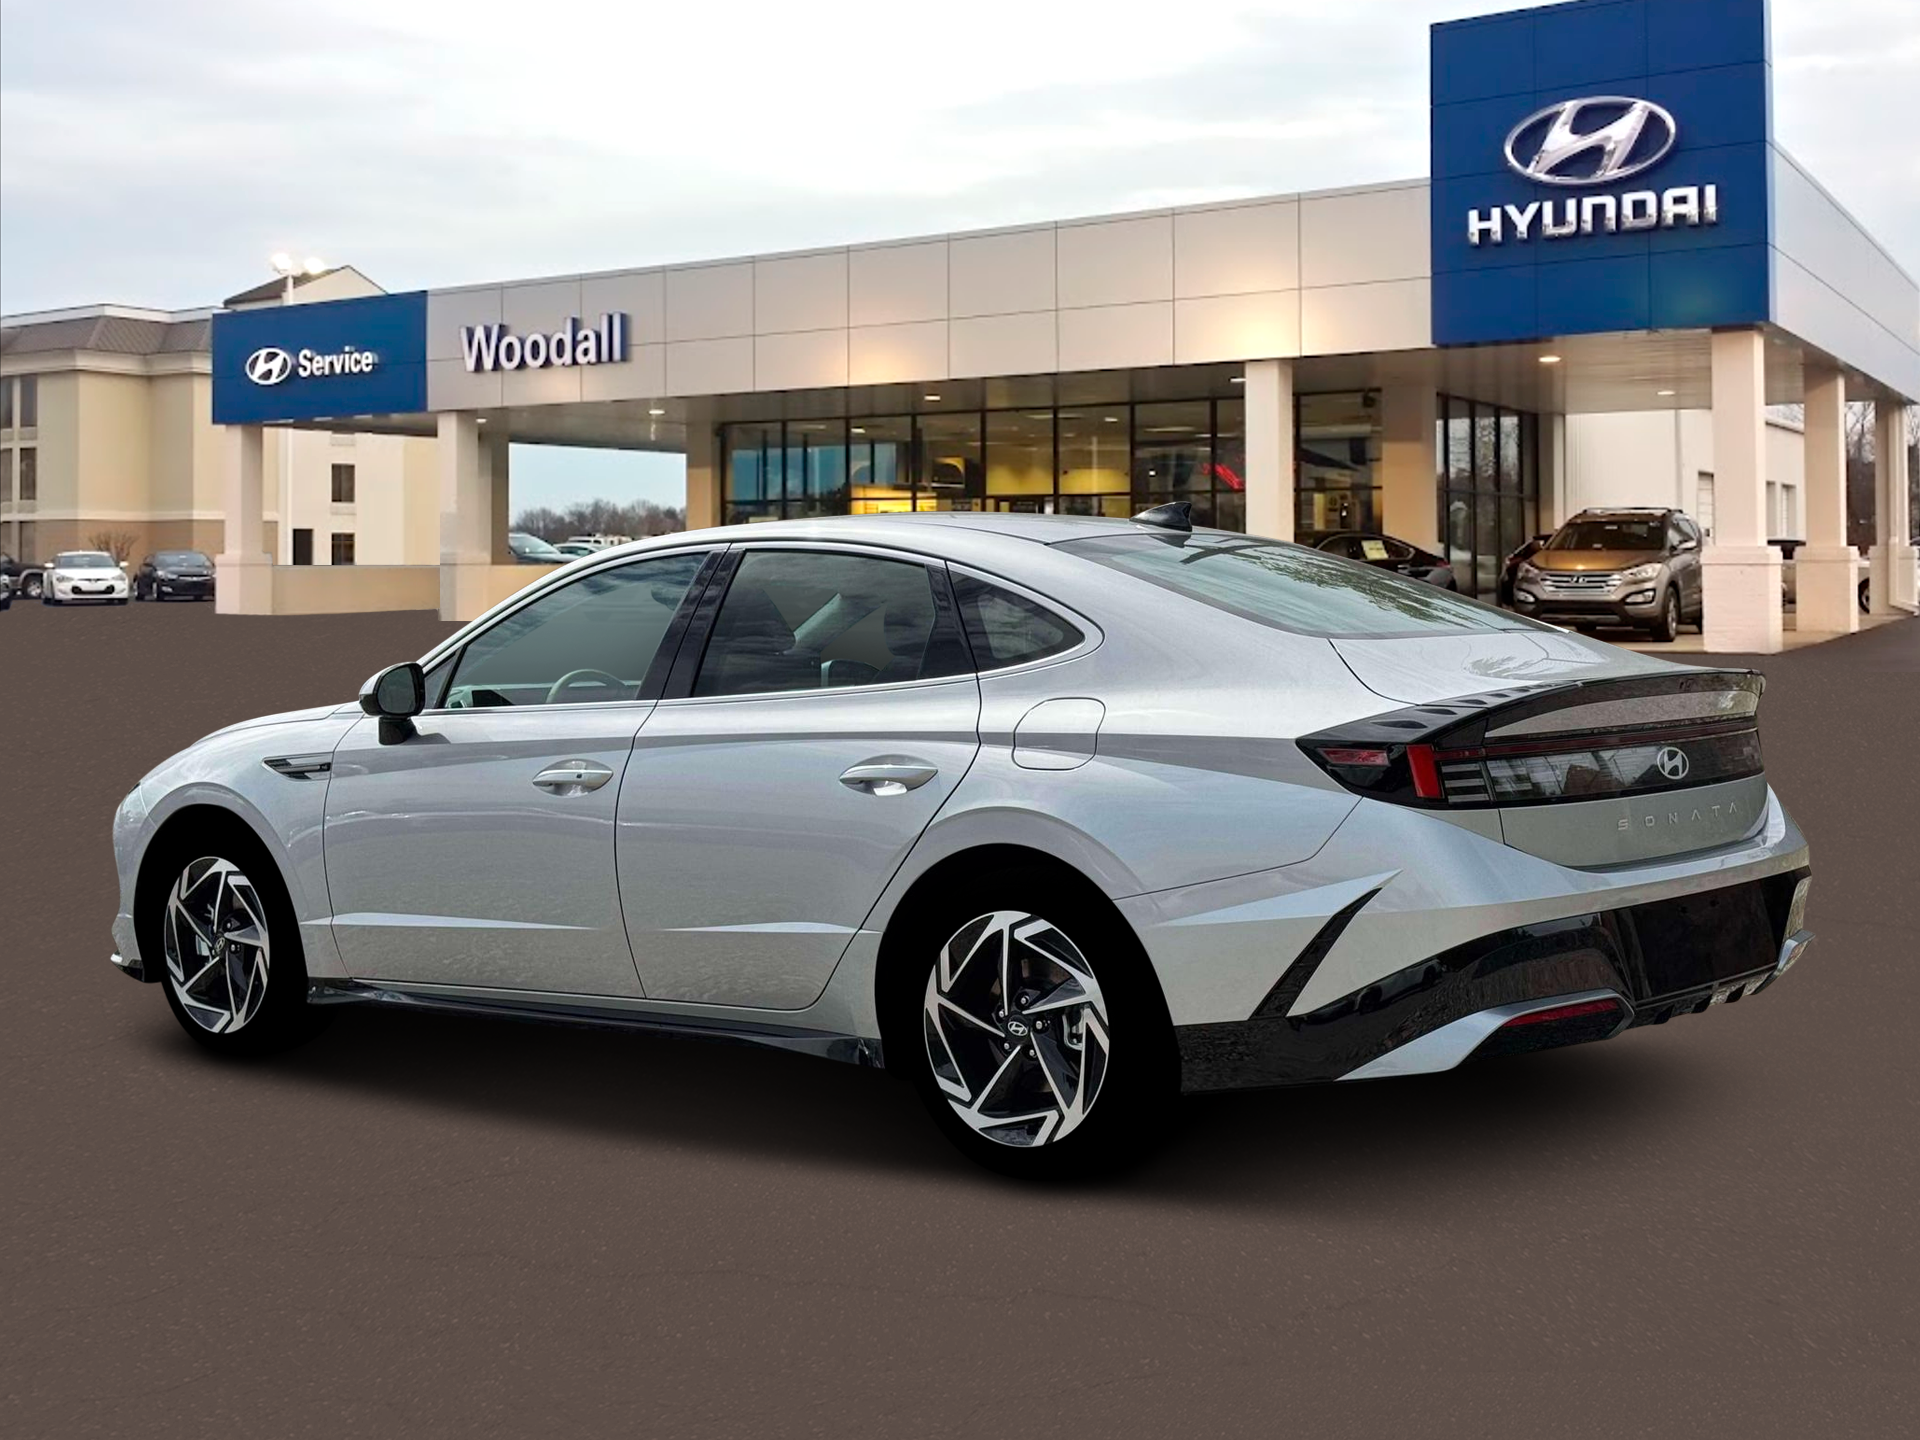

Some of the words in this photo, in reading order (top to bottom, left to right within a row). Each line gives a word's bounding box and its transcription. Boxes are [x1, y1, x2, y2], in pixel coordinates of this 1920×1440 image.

[1468, 184, 1717, 245] HYUNDAI
[298, 346, 374, 377] Service
[460, 311, 626, 372] Woodall
[1617, 801, 1738, 831] SONATA
